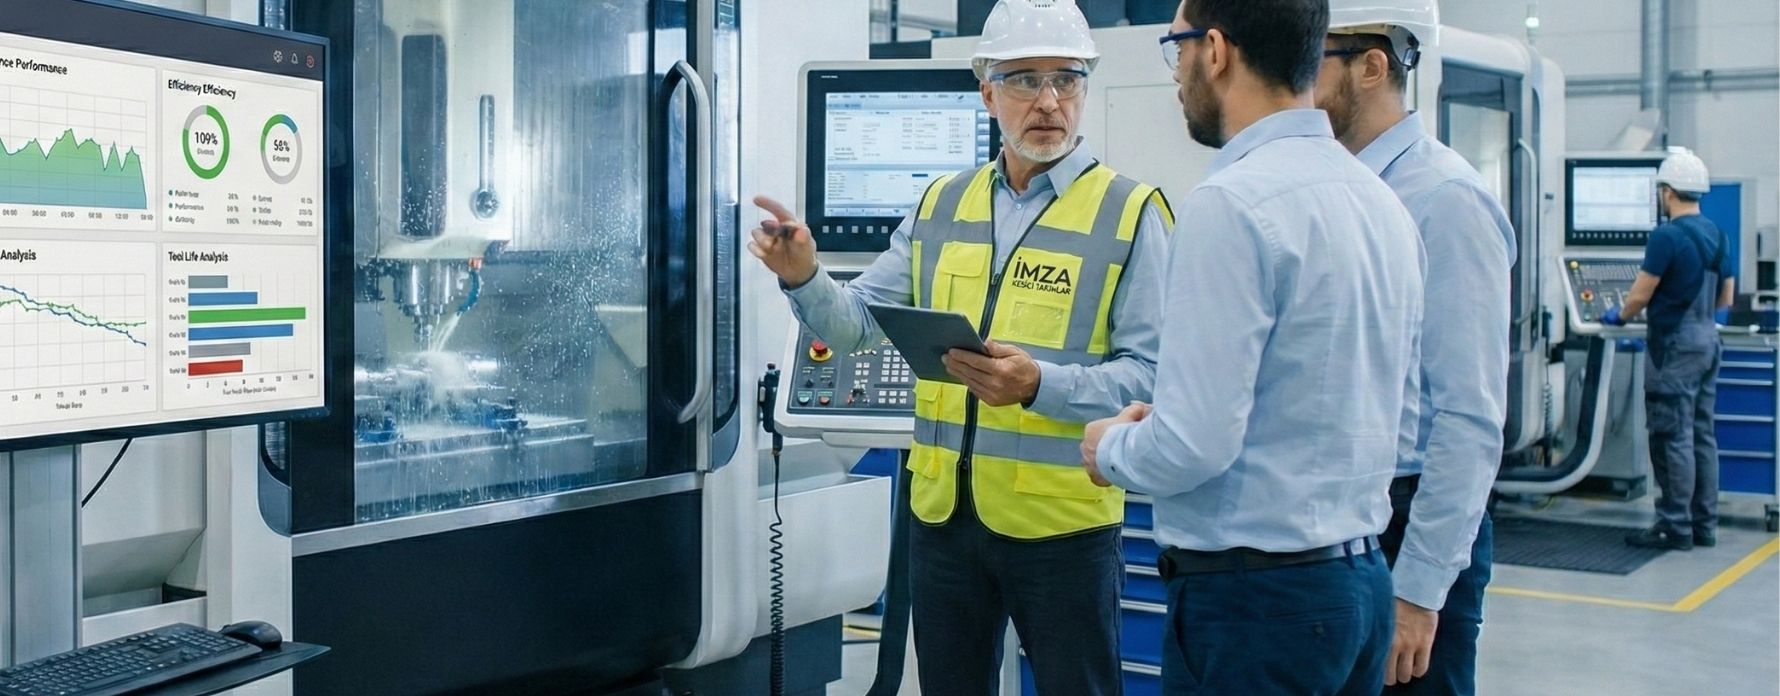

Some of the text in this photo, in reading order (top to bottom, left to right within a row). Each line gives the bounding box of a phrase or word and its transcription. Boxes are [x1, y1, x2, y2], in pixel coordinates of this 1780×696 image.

[195, 132, 218, 146] 109%
[1, 249, 37, 263] Analysis
[168, 251, 229, 264] Tool Life Analysis
[1013, 256, 1072, 287] İMZA
